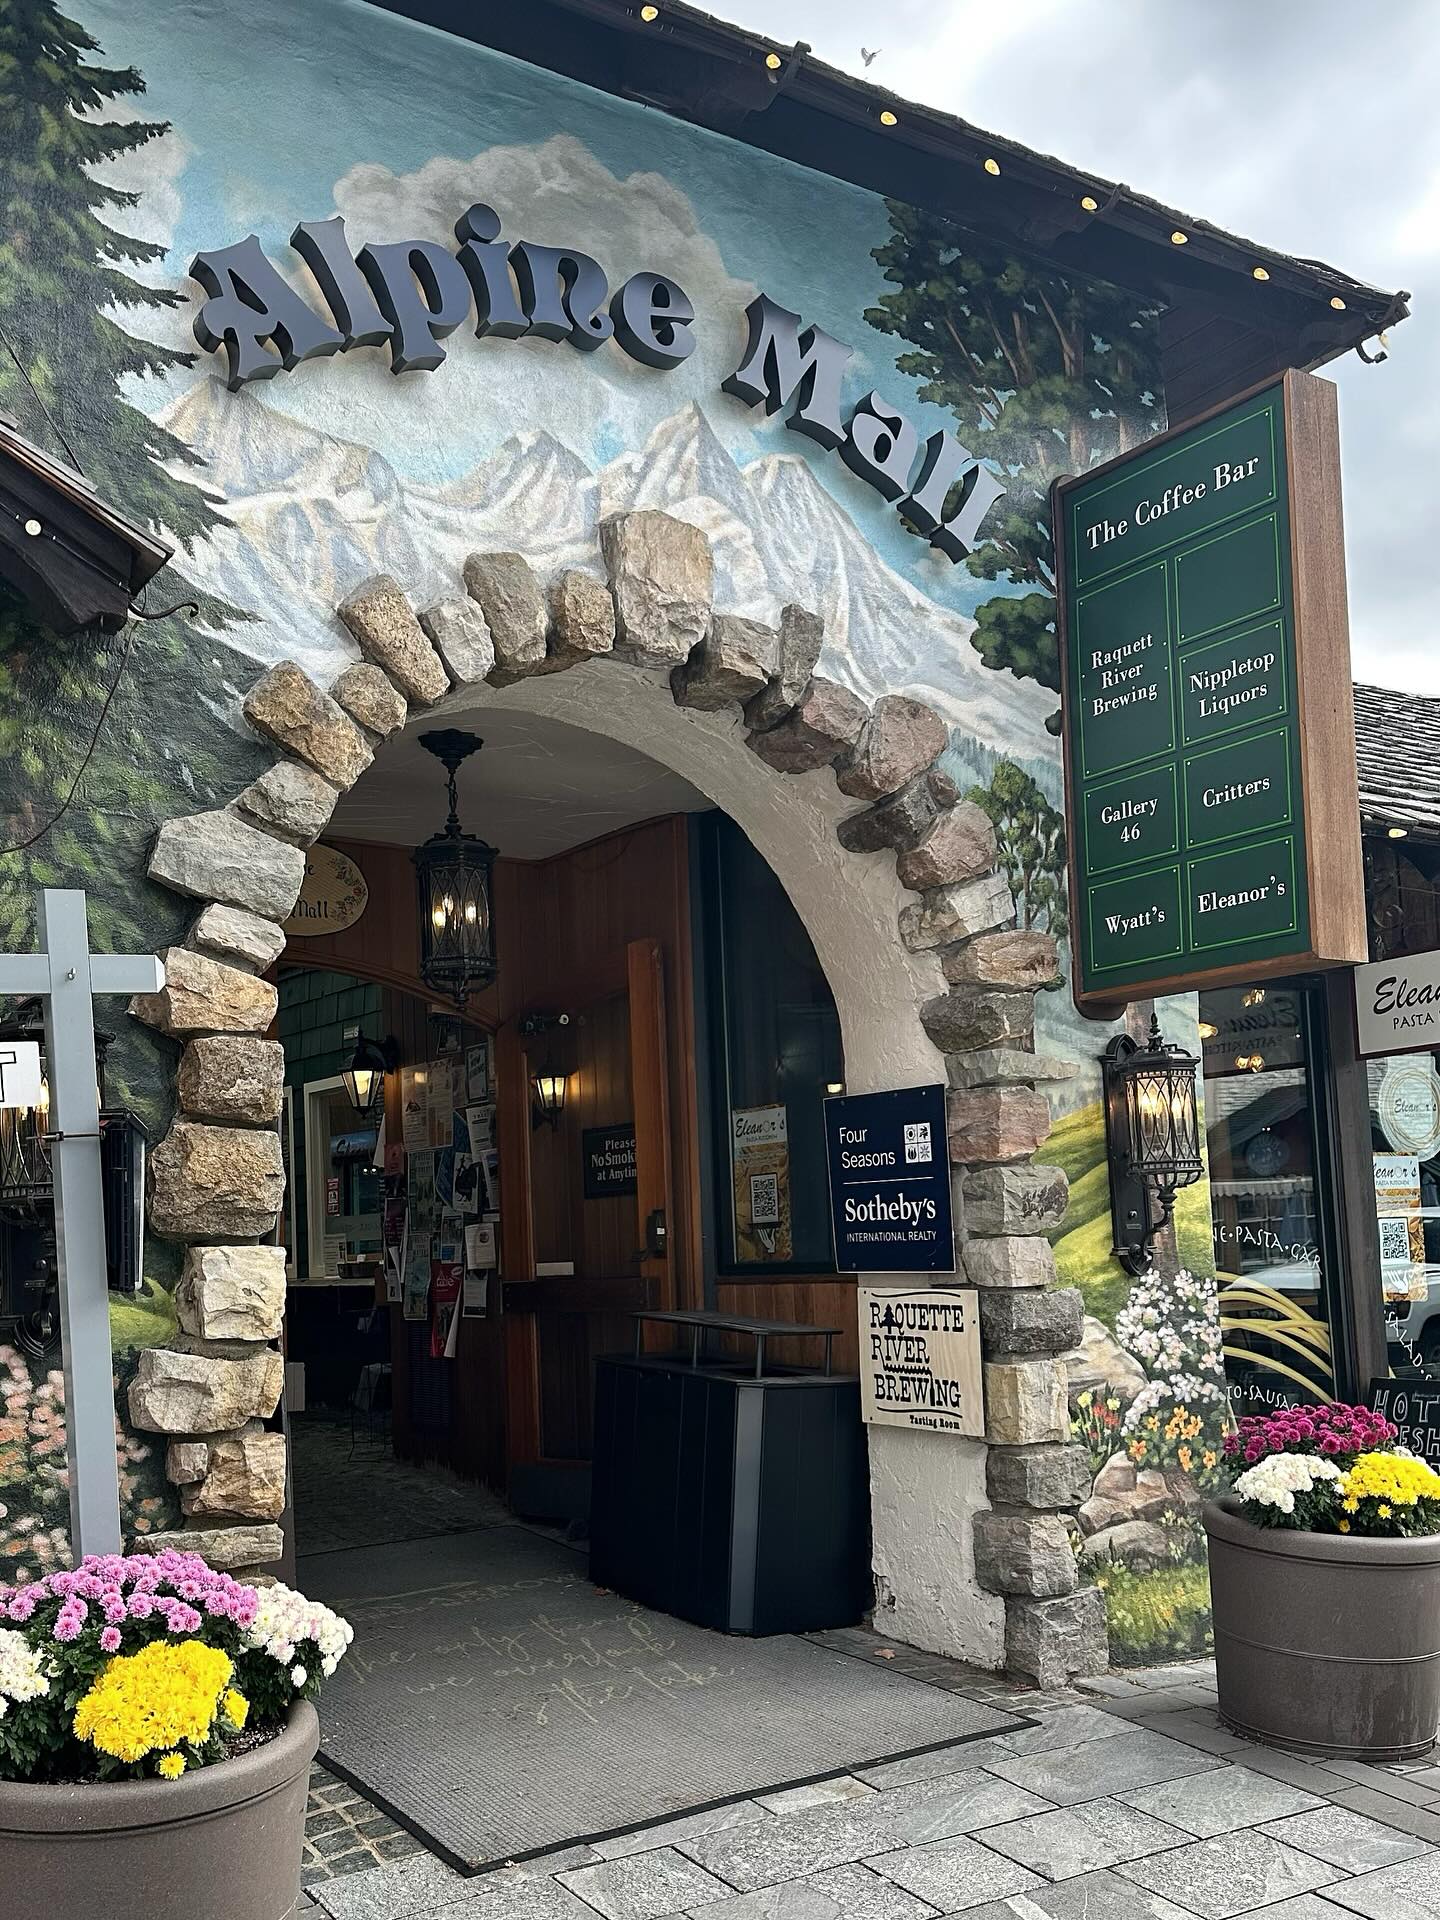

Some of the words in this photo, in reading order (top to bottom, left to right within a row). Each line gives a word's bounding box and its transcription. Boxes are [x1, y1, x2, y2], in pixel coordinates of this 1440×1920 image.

[190, 202, 696, 392] Alpine
[722, 293, 1008, 563] Mall
[1087, 517, 1128, 550] The
[1135, 484, 1206, 526] Coffee
[1213, 457, 1259, 491] Bar
[1091, 633, 1153, 669] Raquett
[1101, 662, 1143, 689] River
[1189, 652, 1275, 693] Nippletop
[1092, 682, 1157, 716] Brewing
[1199, 682, 1268, 717] Liquors
[1202, 777, 1271, 808] Critters
[1101, 798, 1158, 825] Gallery
[1120, 823, 1141, 843] 46
[1198, 876, 1286, 913] Eleanor's
[1105, 906, 1166, 935] Wyatt's
[1393, 1012, 1434, 1030] PASTA
[605, 1139, 636, 1150] Please
[839, 1127, 868, 1145] Four
[592, 1152, 604, 1168] No
[841, 1151, 896, 1169] Seasons
[597, 1170, 606, 1181] at
[845, 1193, 936, 1226] Sotheby's
[846, 1231, 907, 1243] INTERNATIONAL
[908, 1230, 936, 1242] REALTY
[869, 1302, 964, 1335] RAQUETTE
[870, 1334, 930, 1364] RIVER
[874, 1374, 961, 1408] BREWING
[910, 1415, 938, 1429] Tasting
[940, 1418, 960, 1429] Room
